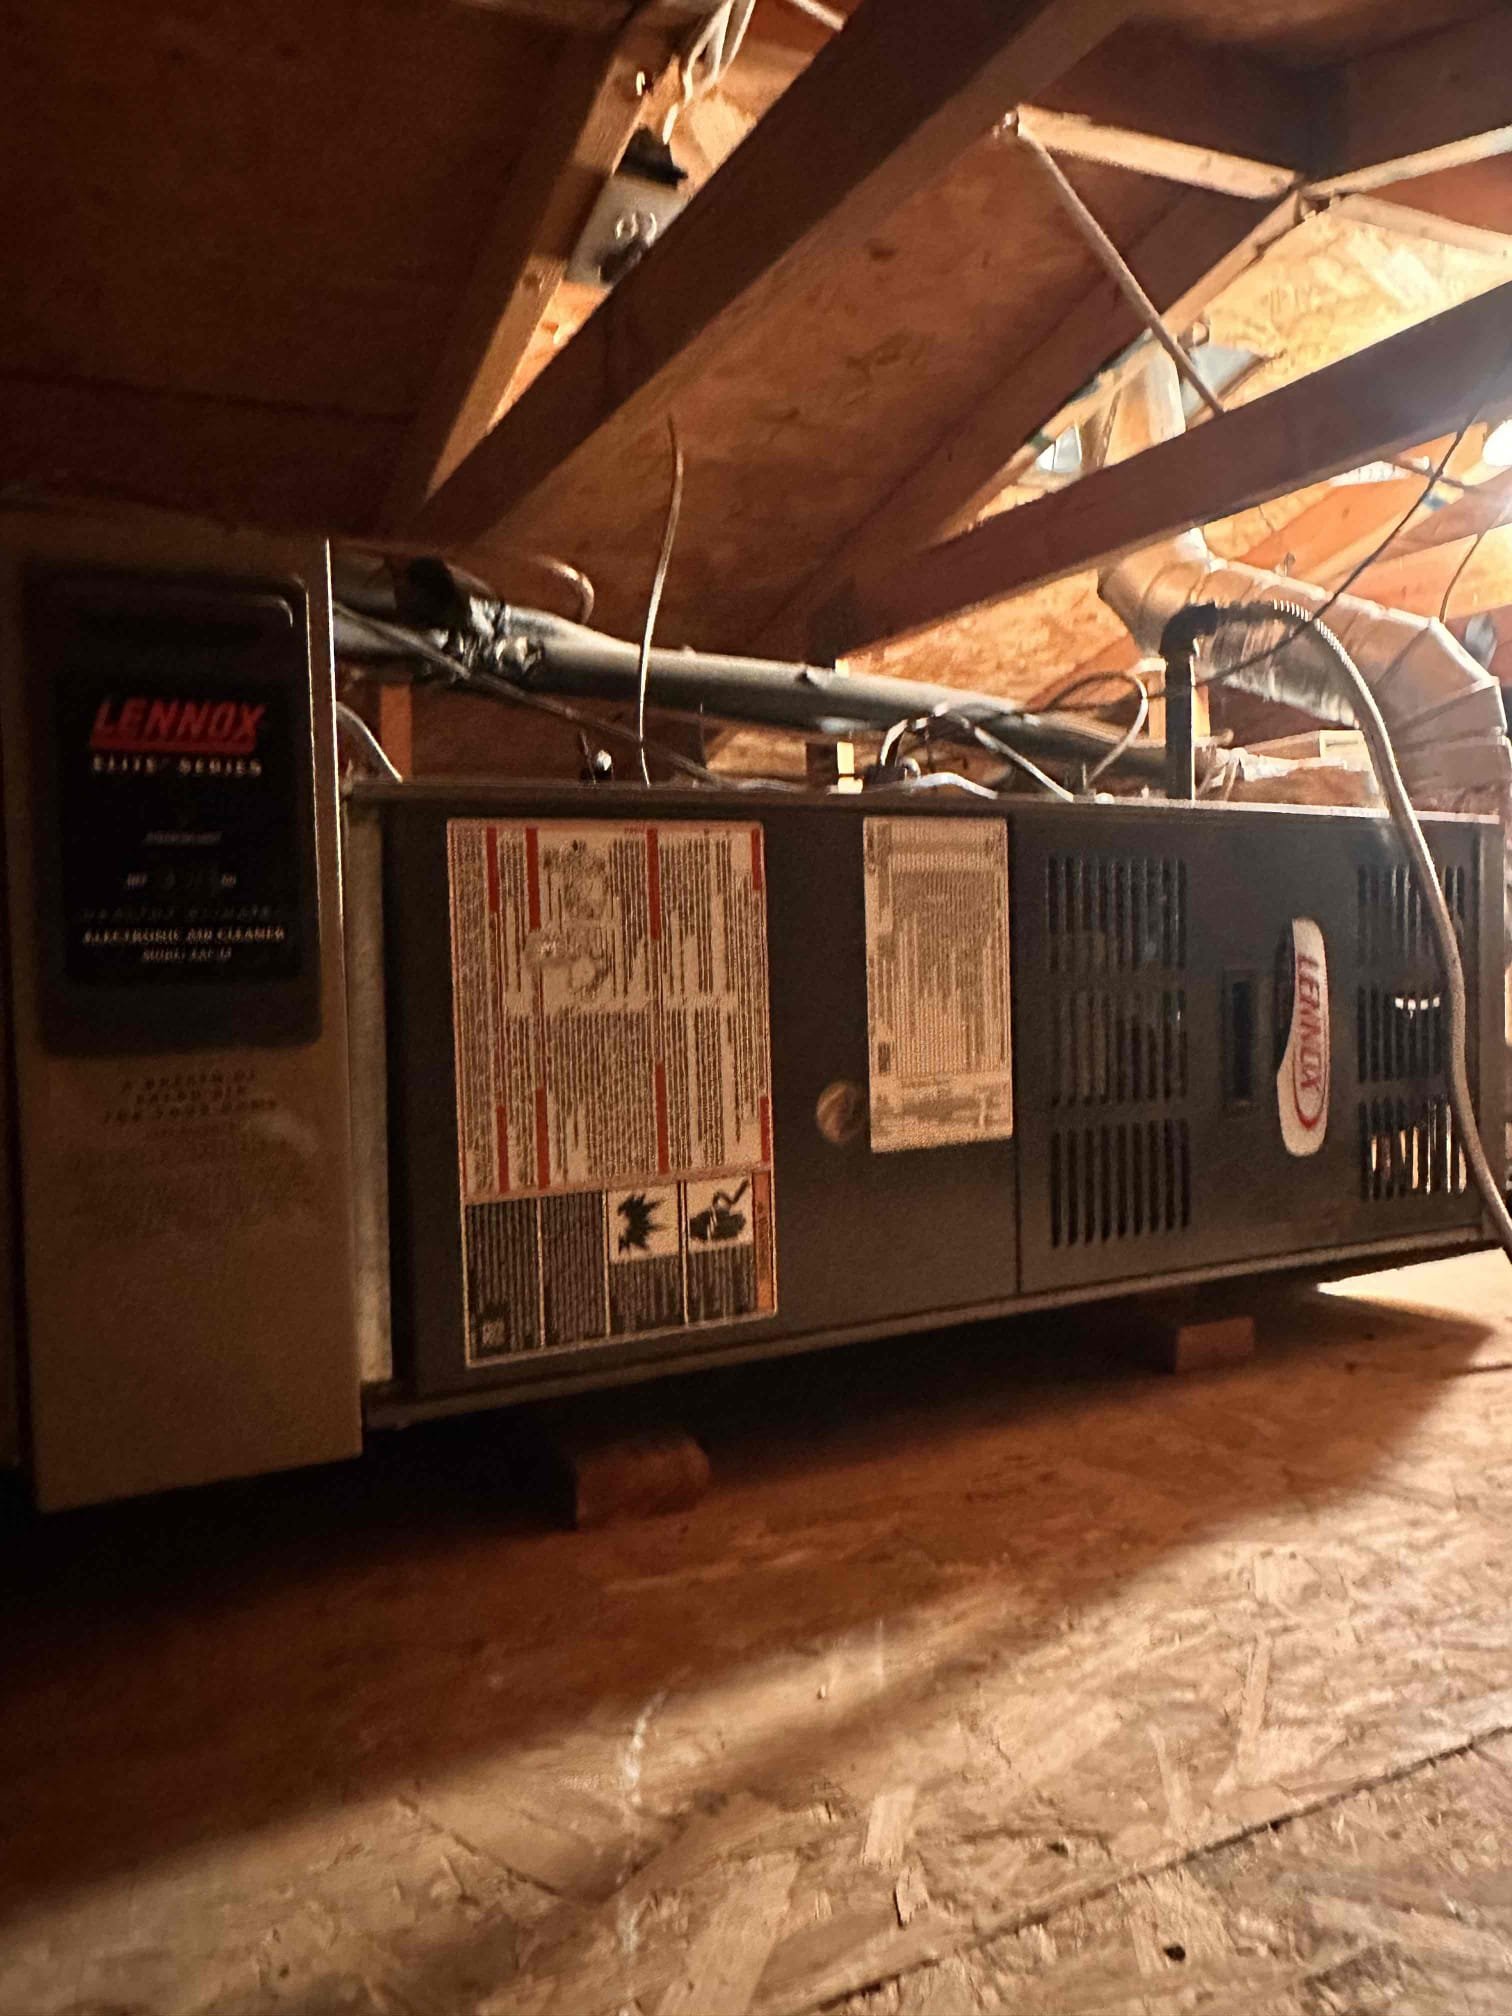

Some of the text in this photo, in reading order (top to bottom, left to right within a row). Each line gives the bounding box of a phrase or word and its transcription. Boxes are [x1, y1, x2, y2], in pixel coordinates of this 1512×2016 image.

[93, 697, 266, 748] LENNOX
[93, 755, 263, 777] ELITE SERIES
[1297, 953, 1322, 1093] LENNOX
